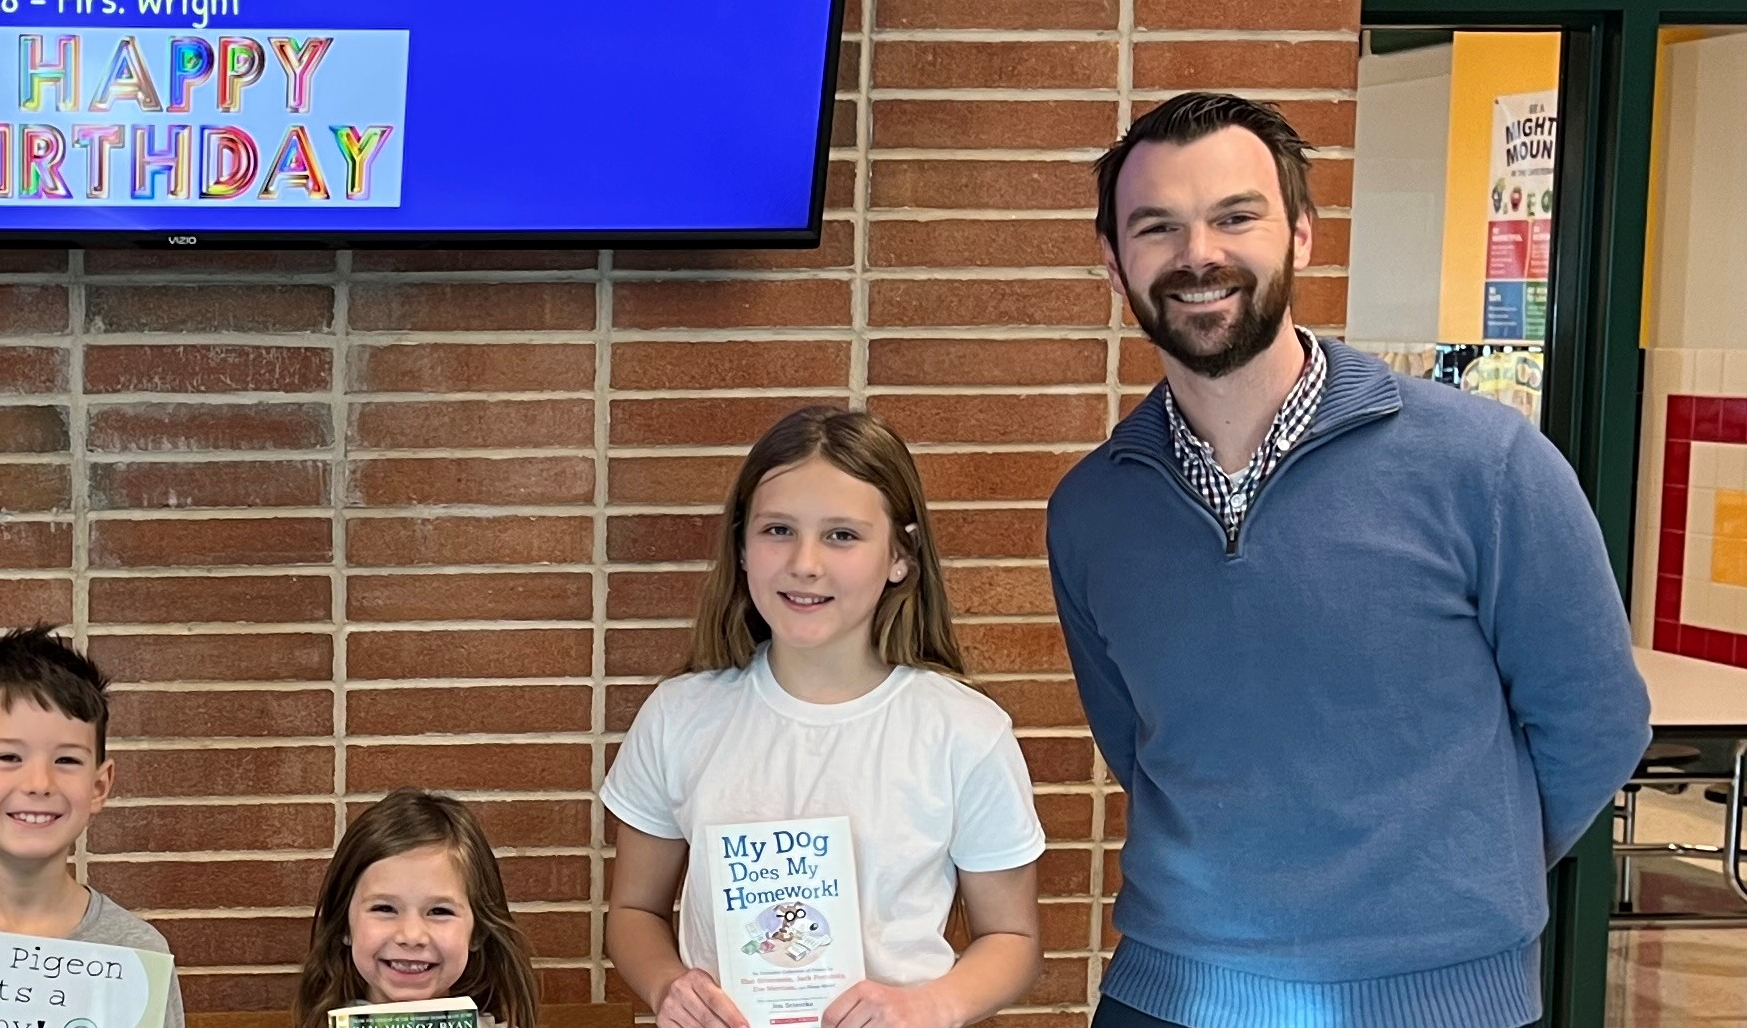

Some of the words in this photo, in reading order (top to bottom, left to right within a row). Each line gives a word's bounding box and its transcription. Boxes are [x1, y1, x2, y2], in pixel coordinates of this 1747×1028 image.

[138, 0, 239, 28] Wright
[18, 34, 334, 114] HAPPY
[1506, 117, 1557, 144] MIGHT
[1506, 140, 1553, 166] MOUN
[168, 236, 197, 245] VIZIO
[722, 835, 766, 862] My
[773, 831, 829, 856] Dog
[728, 862, 780, 882] Does
[786, 857, 819, 879] My
[723, 879, 839, 911] Homework!
[10, 946, 124, 980] Pigeon
[49, 989, 66, 1007] a
